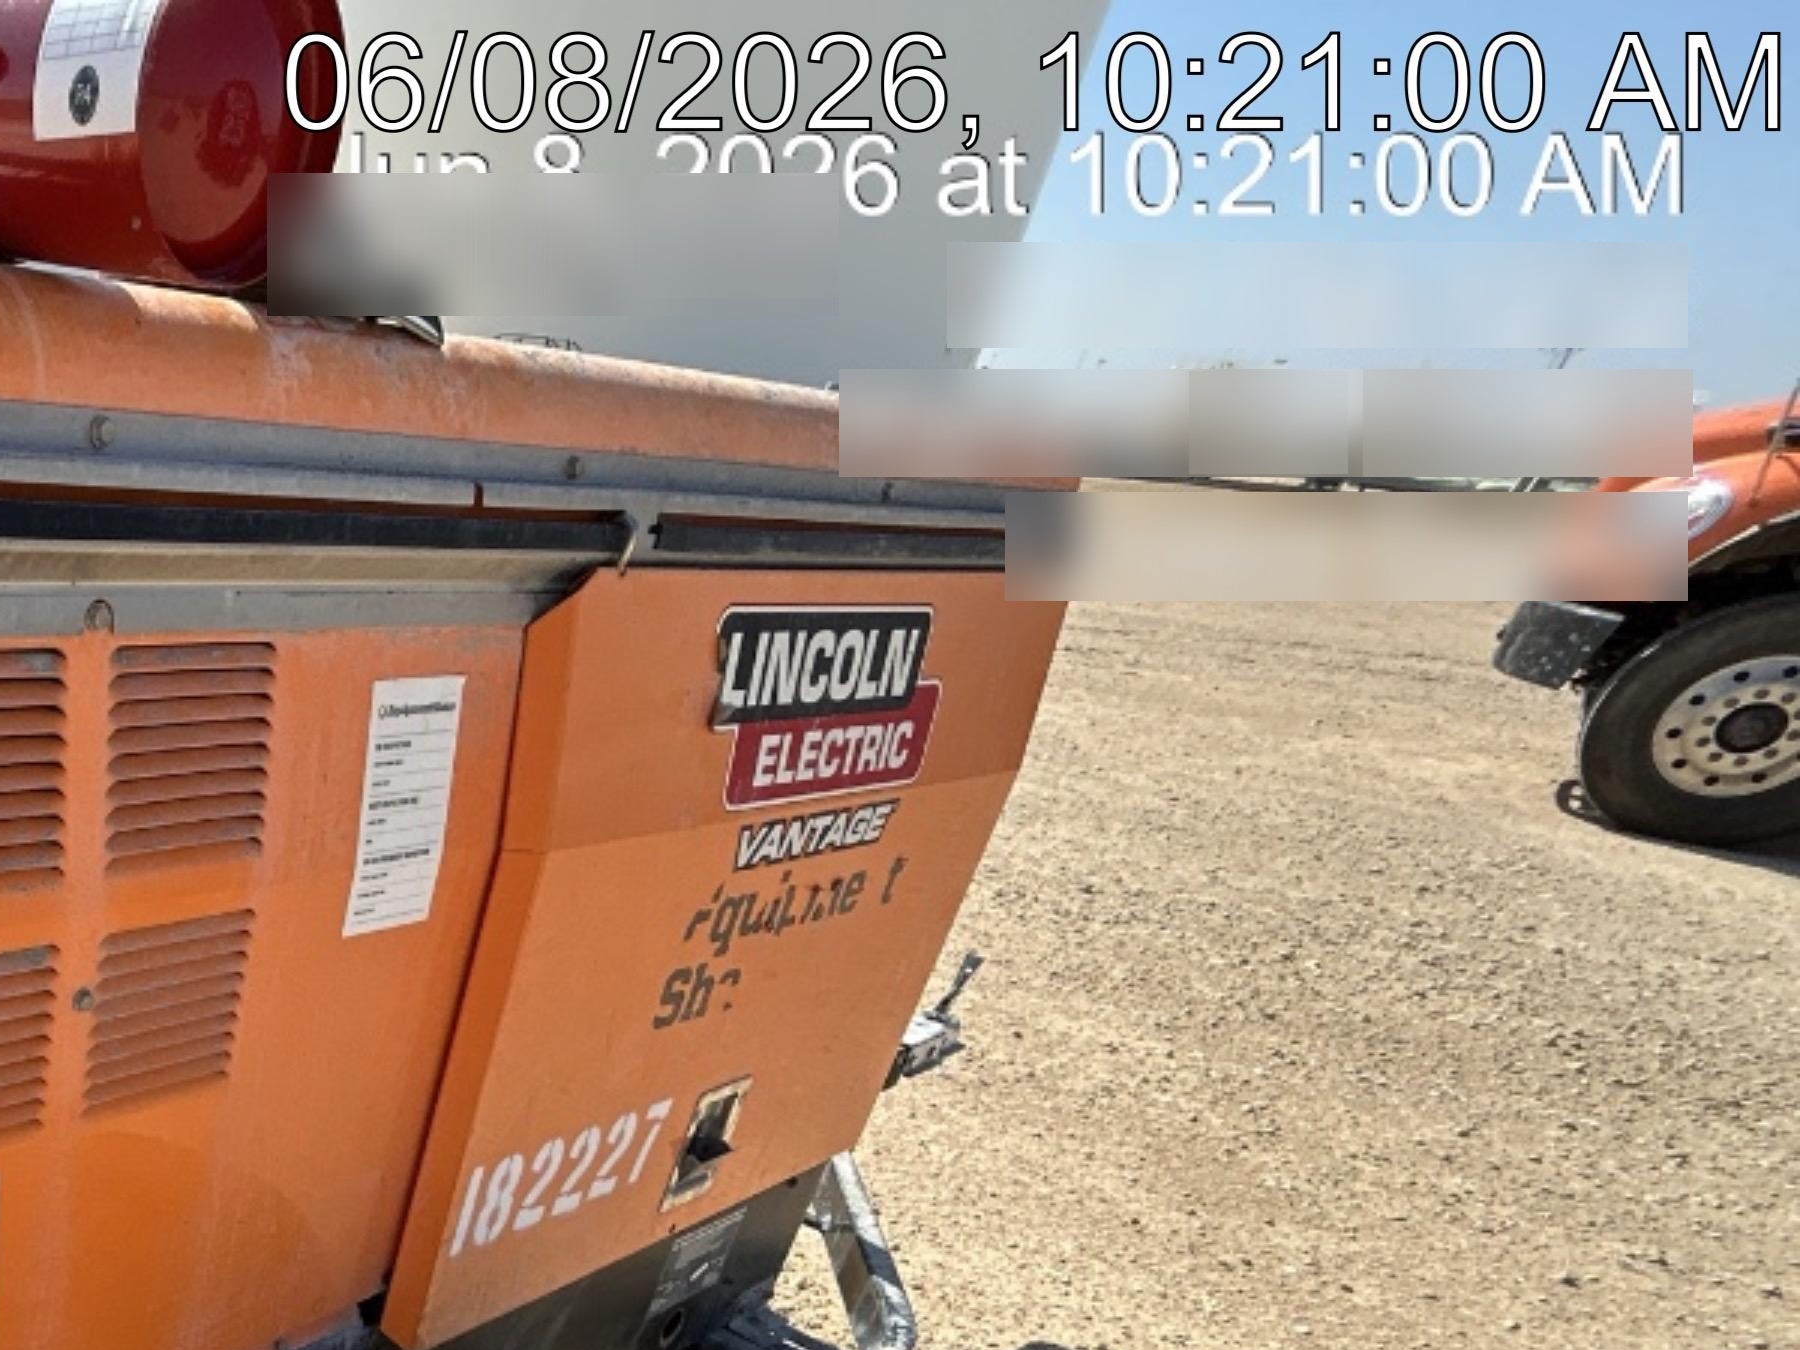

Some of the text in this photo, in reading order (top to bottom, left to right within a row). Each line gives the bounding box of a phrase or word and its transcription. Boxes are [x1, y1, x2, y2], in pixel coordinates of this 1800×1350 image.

[721, 629, 921, 711] LINCOLN
[751, 721, 915, 788] ELECTRIC
[736, 803, 896, 870] VANTAGE
[449, 1097, 673, 1257] 182227
